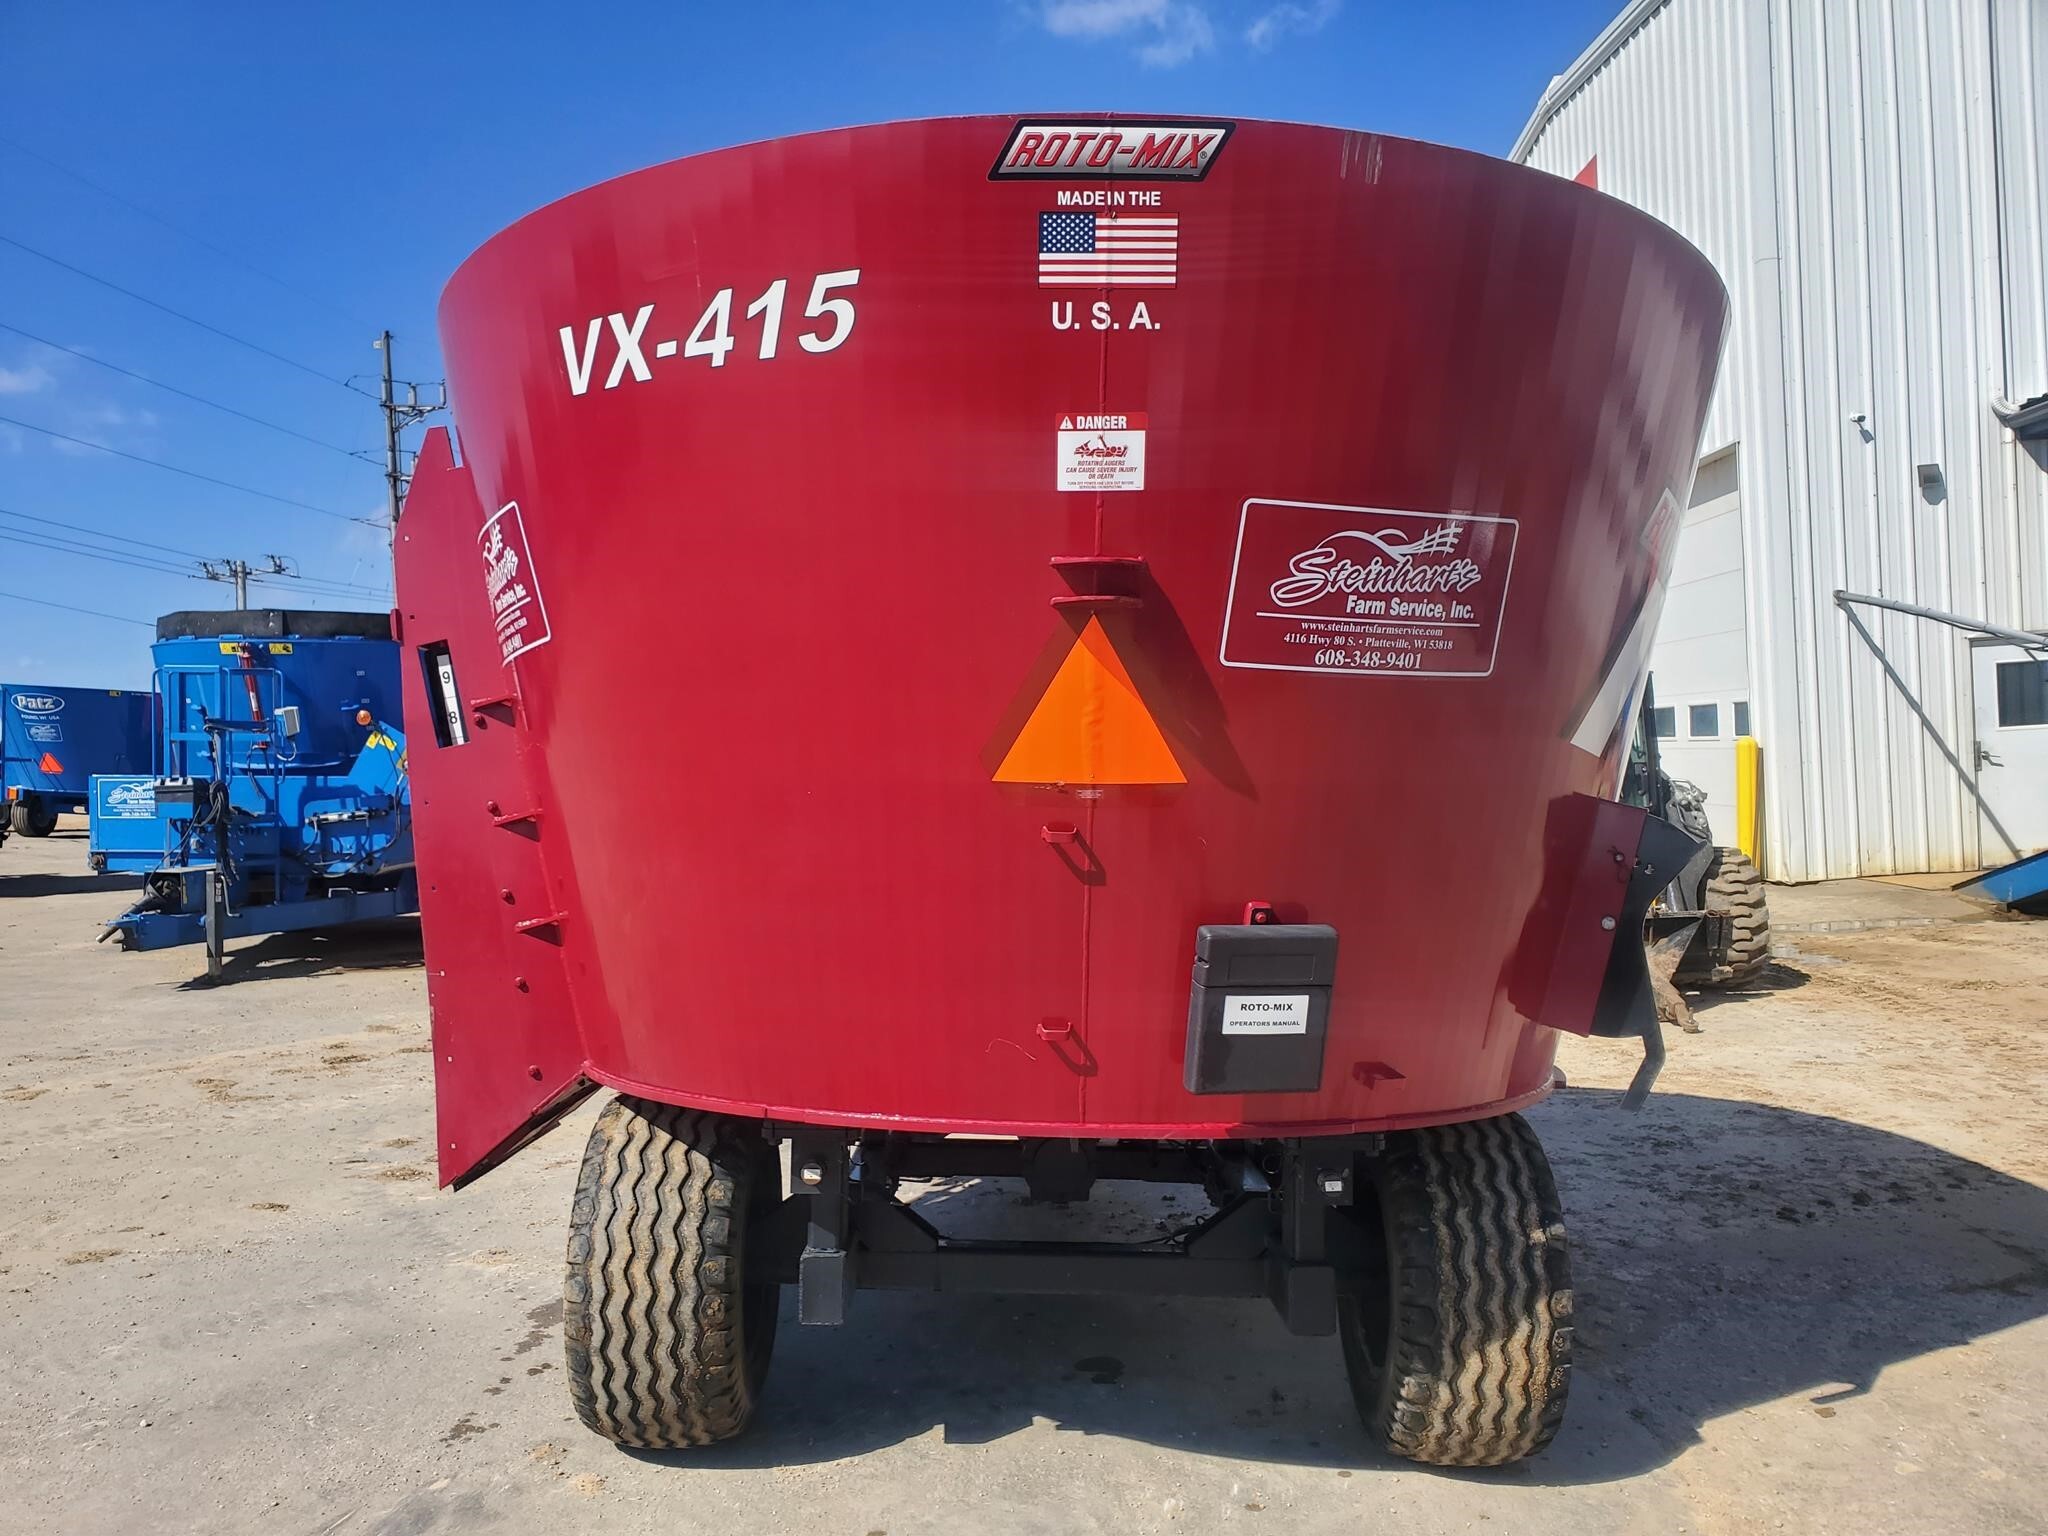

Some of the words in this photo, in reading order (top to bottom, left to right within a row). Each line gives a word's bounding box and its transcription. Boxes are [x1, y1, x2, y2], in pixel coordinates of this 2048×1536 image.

[1006, 131, 1217, 169] ROTO-MIX
[1057, 191, 1105, 206] MADE
[1107, 191, 1125, 206] IN
[1129, 191, 1161, 206] THE
[558, 268, 861, 396] VX-415
[1076, 415, 1127, 430] DANGER
[1270, 547, 1482, 608] Steinhart's
[1346, 595, 1386, 615] Farm
[1389, 597, 1447, 621] Service,
[1450, 600, 1475, 619] Inc.
[1301, 621, 1444, 637] www.steinhartsfarmservice.com
[1283, 633, 1307, 643] 4116
[1309, 634, 1331, 647] Hwy
[1333, 635, 1346, 646] 80
[1347, 636, 1357, 646] S.
[1364, 637, 1412, 650] Platteville,
[1414, 640, 1428, 649] WI
[1428, 640, 1453, 650] 53818
[1314, 648, 1423, 669] 608-348-9401
[441, 670, 451, 684] 9
[16, 695, 56, 710] Patz
[448, 711, 459, 725] 8
[1240, 1003, 1293, 1012] ROTO-MIX
